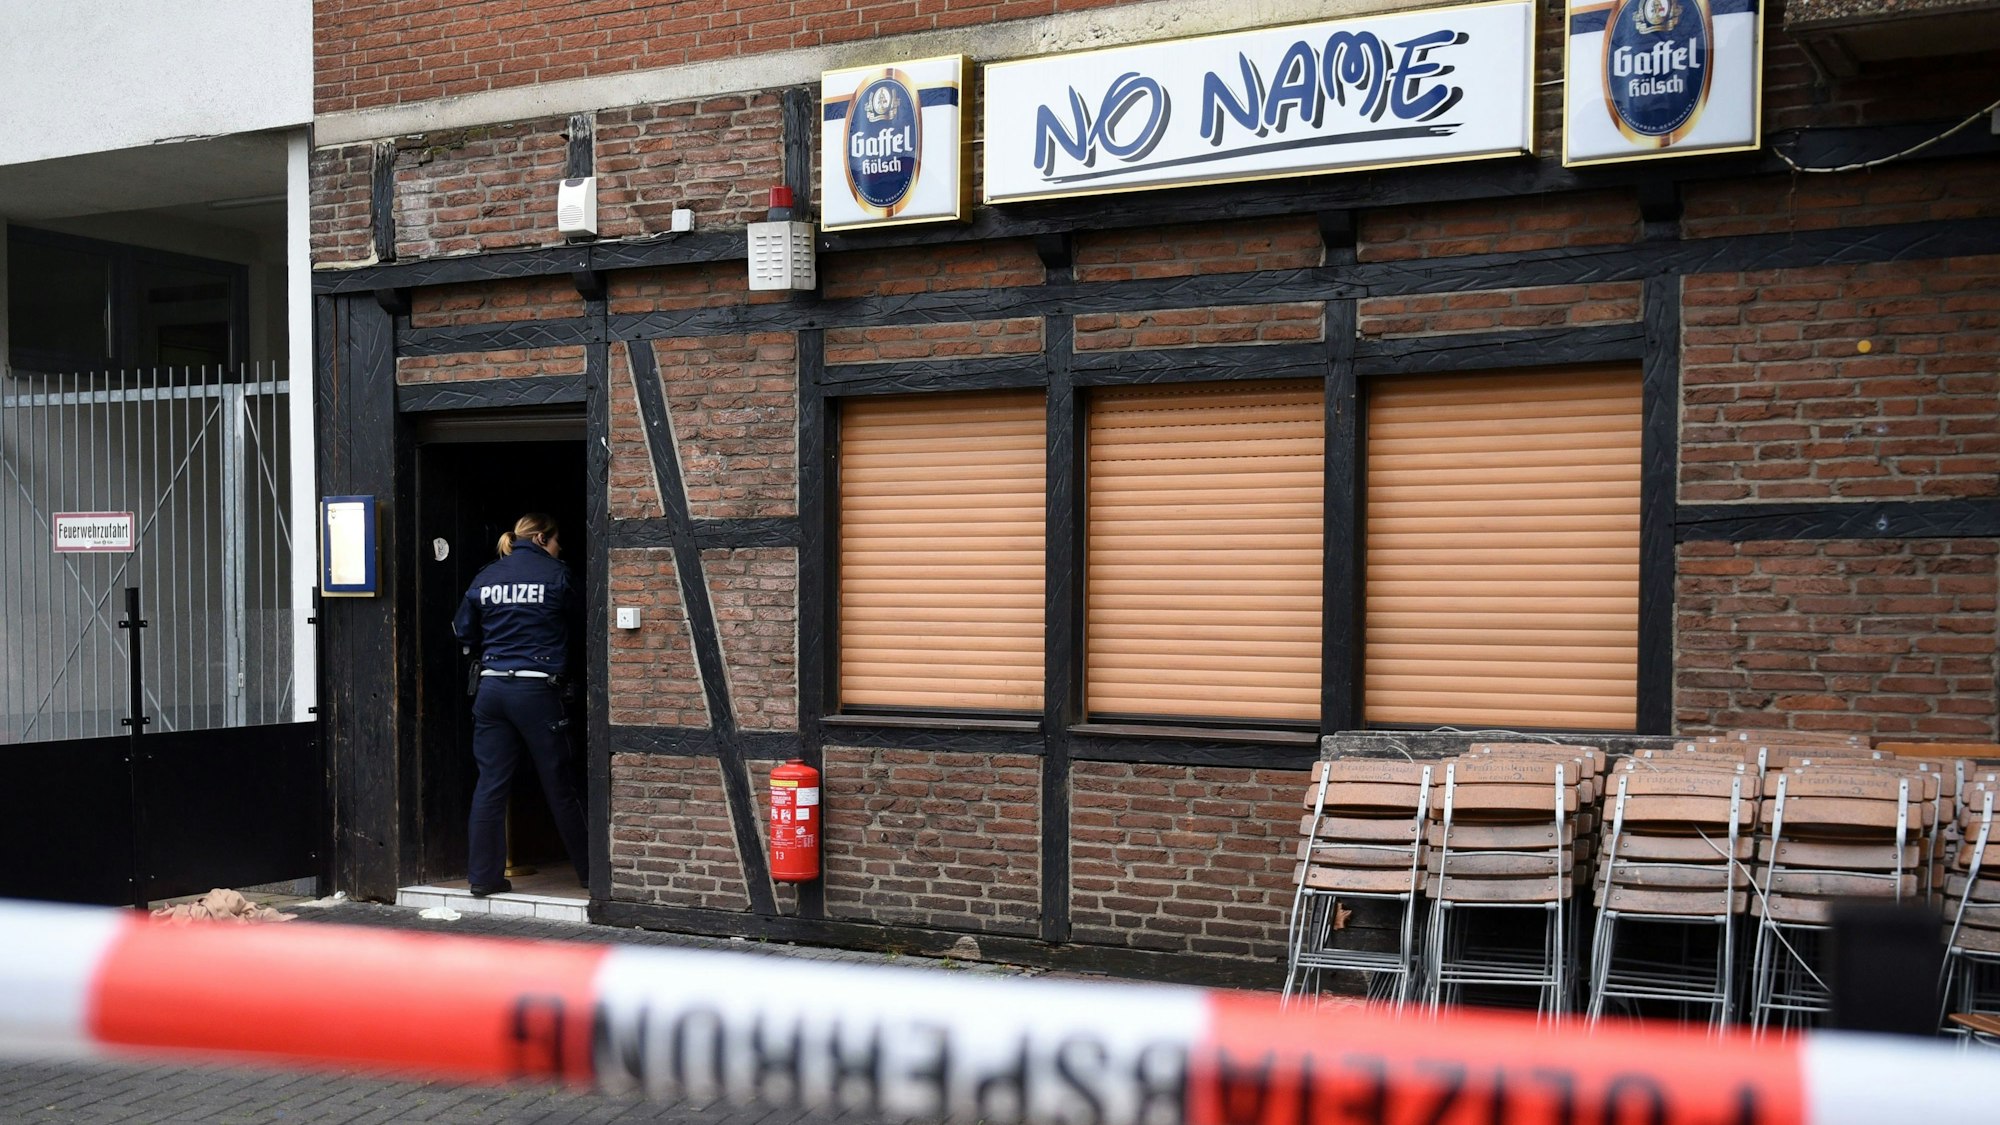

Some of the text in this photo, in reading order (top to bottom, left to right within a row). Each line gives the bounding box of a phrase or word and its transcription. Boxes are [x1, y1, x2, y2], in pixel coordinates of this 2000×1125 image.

[1613, 37, 1701, 77] Gaffel
[1628, 74, 1684, 98] Kölsch
[1033, 29, 1470, 177] NO NAME
[851, 125, 914, 158] Gaffel
[862, 156, 902, 175] Kölsch
[58, 523, 129, 539] Feuerwehrzufahrt
[480, 583, 545, 605] POLIZEI
[775, 850, 785, 860] 13
